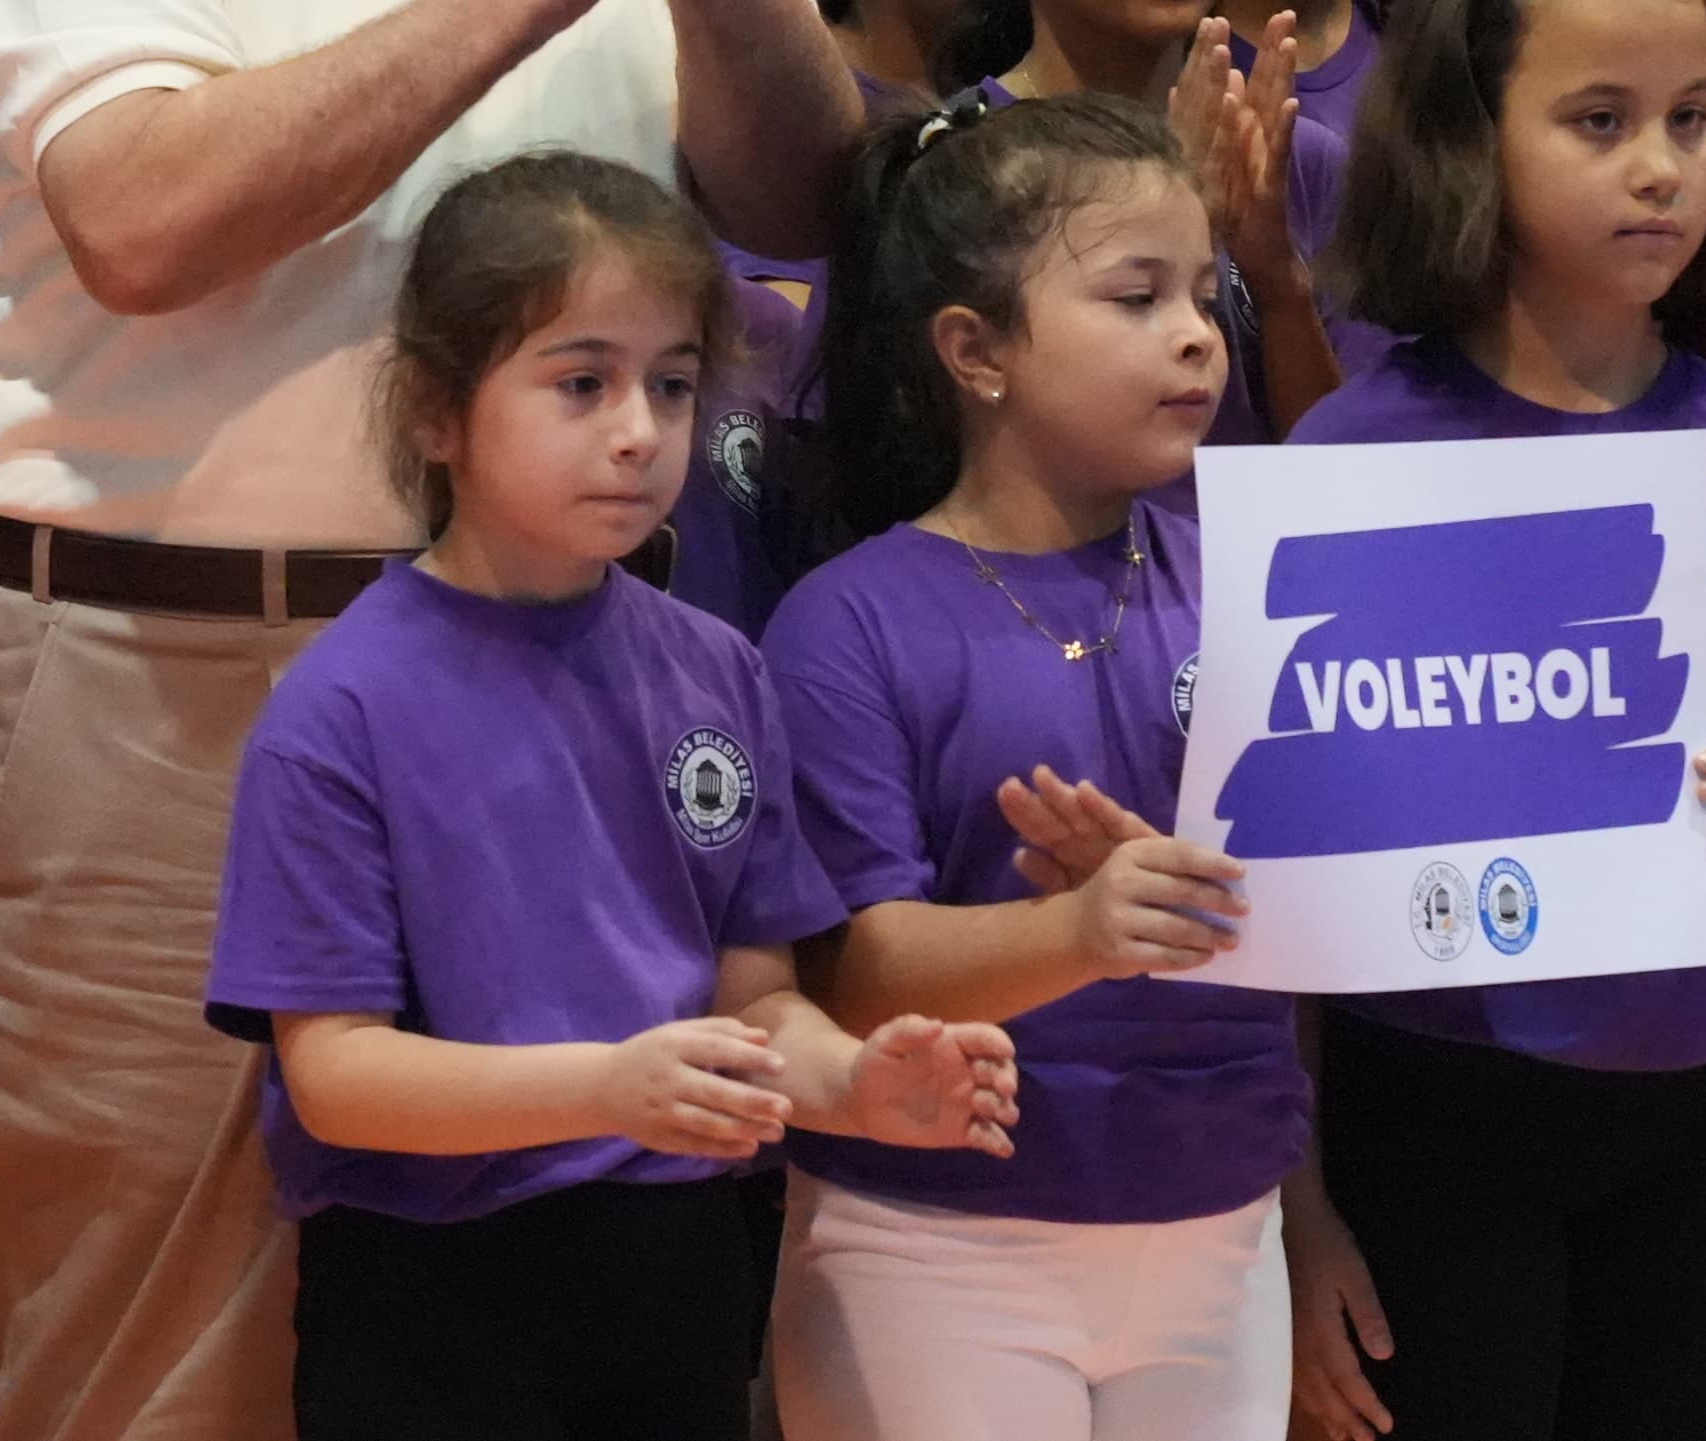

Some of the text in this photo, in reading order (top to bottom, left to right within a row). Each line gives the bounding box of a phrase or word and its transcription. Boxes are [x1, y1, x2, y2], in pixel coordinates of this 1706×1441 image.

[1295, 647, 1627, 732] VOLEYBOL
[667, 731, 754, 797] MİLAS BELEDİYESİ
